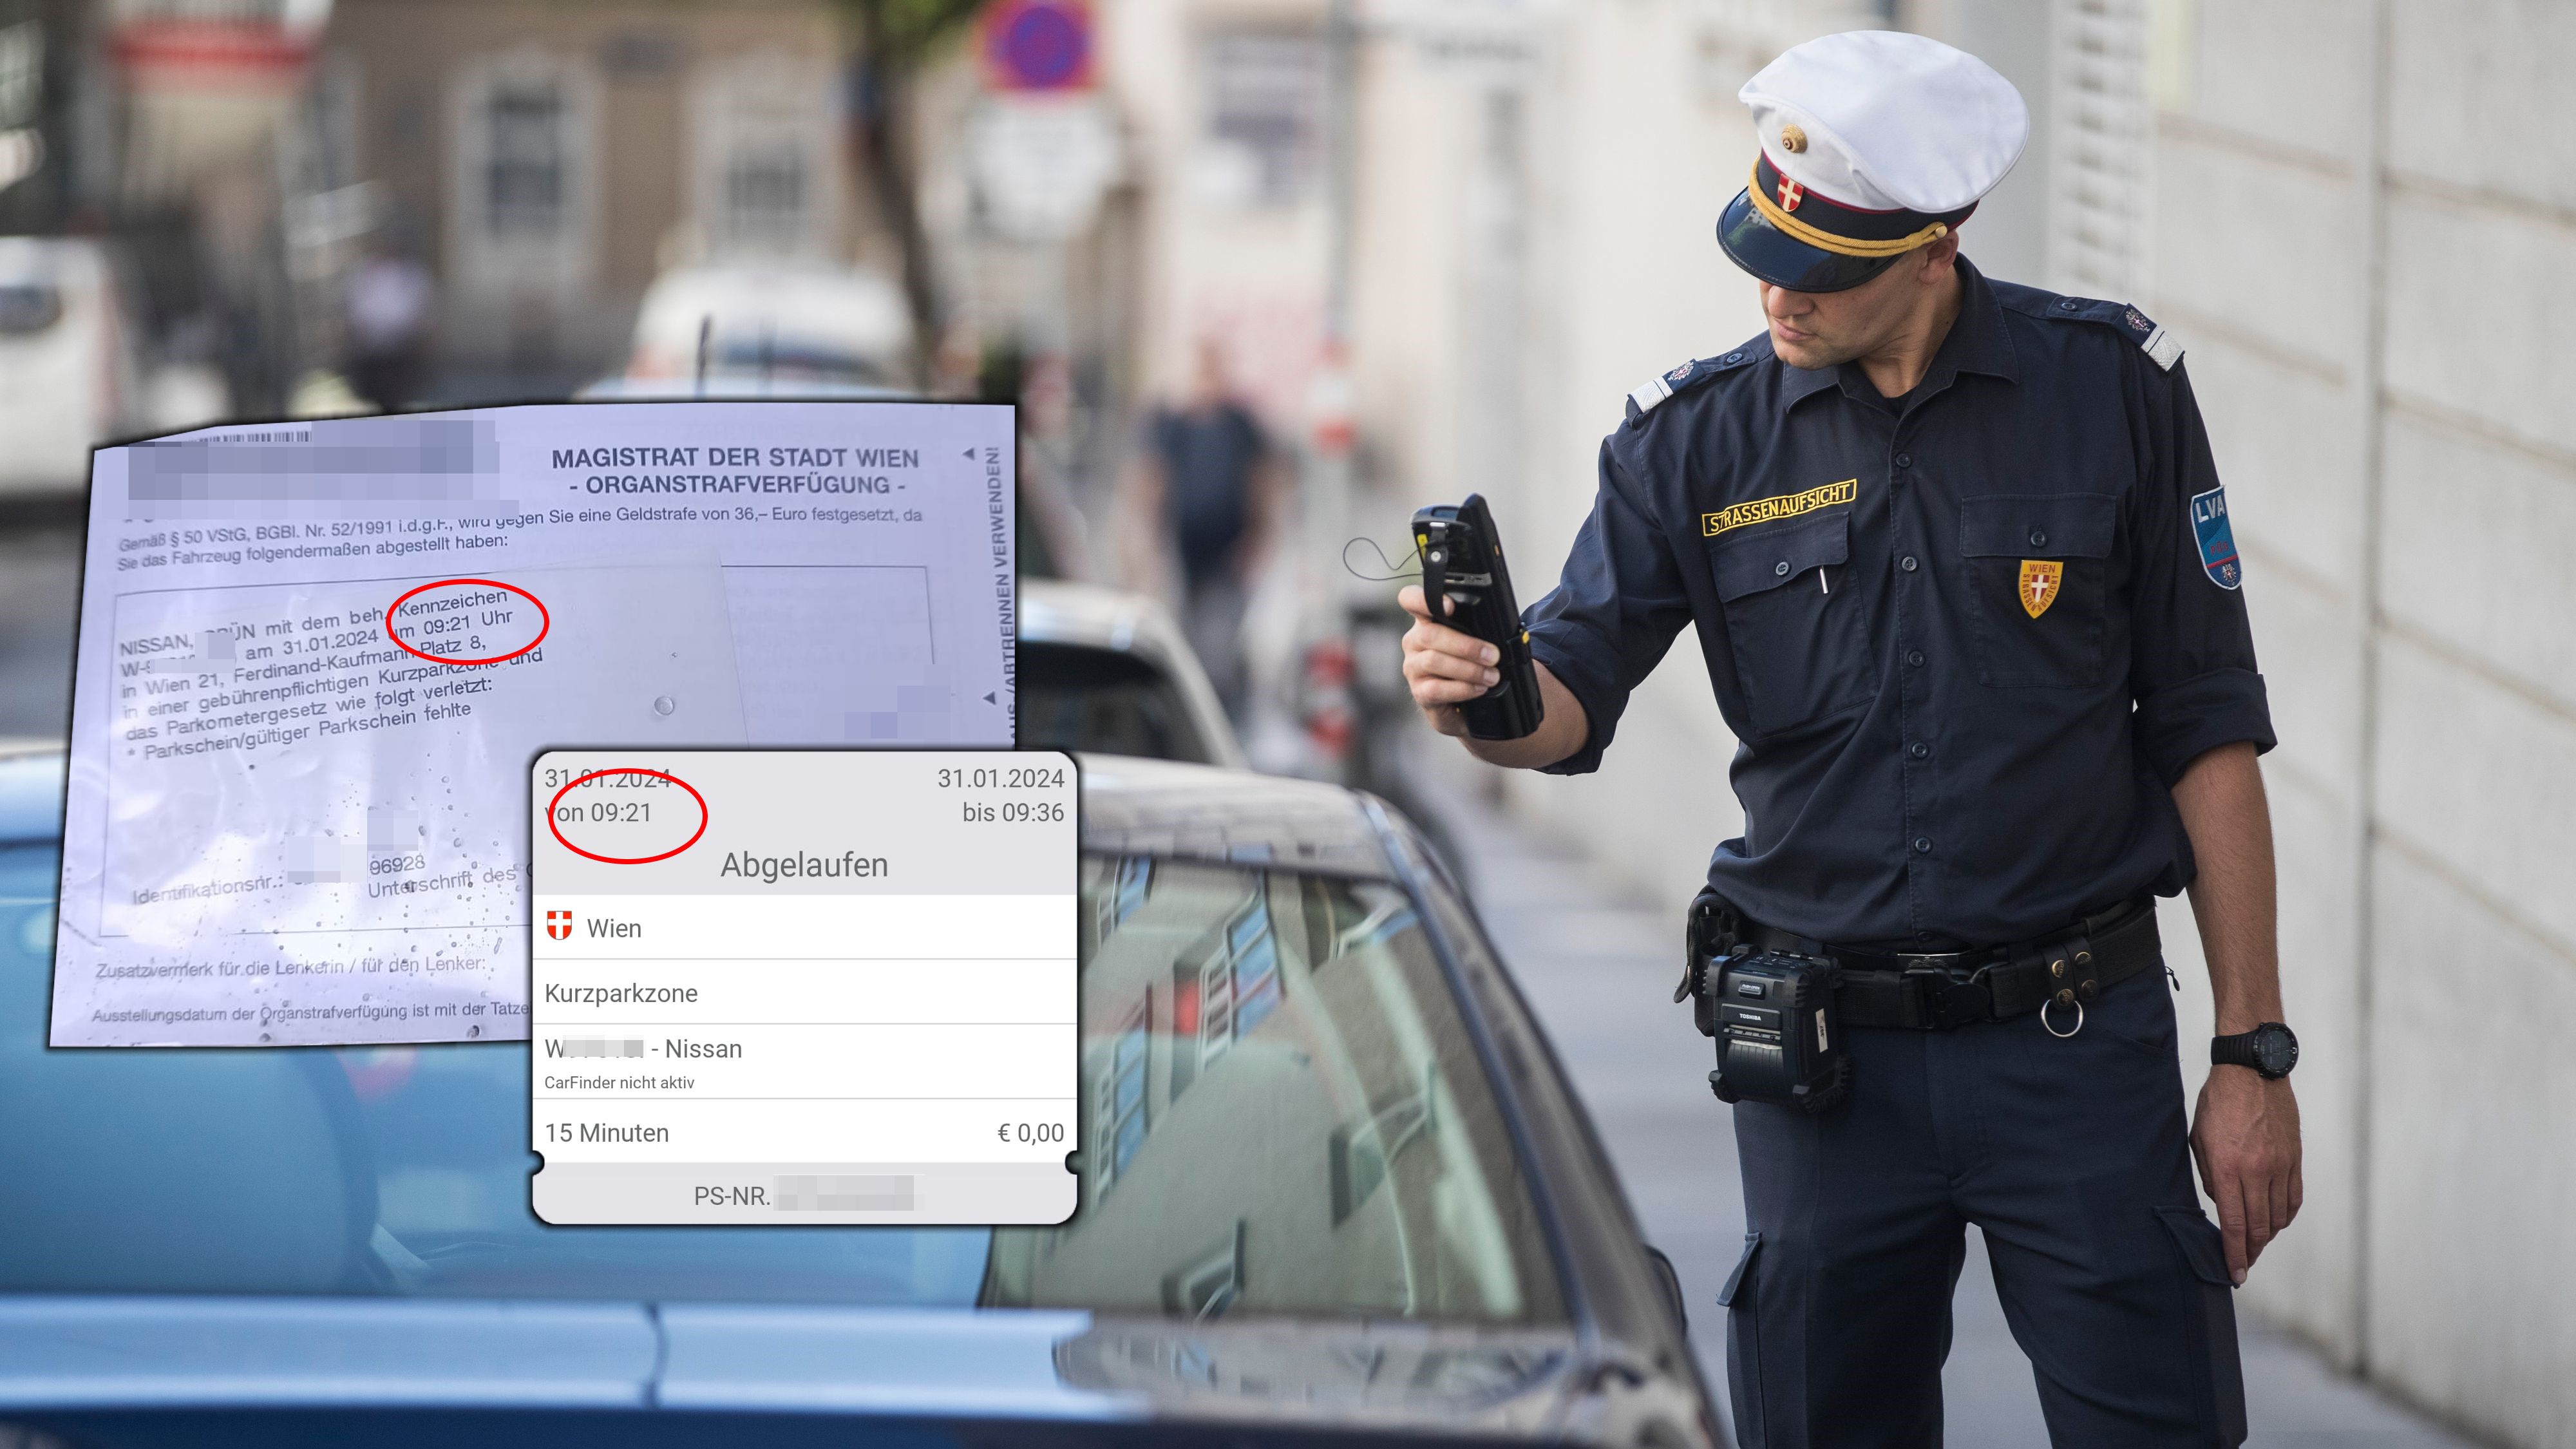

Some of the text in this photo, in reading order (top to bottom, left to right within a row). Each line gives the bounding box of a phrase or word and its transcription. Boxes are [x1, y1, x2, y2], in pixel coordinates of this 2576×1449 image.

[552, 448, 919, 469] MAGISTRAT DER STADT WIEN
[586, 471, 890, 494] ORGANSTRAFVERFÜGUNG
[985, 447, 1008, 568] VERWENDEN!
[1710, 484, 1850, 533] STRASSENAUFSICHT
[2195, 495, 2226, 523] LVA
[119, 533, 166, 552] Gemäß
[170, 531, 180, 548] §
[184, 529, 203, 544] 50
[207, 527, 251, 543] VStG,
[305, 524, 326, 538] Nr.
[331, 520, 392, 536] 52/1991
[549, 509, 574, 523] Sie
[579, 508, 611, 522] eine
[616, 507, 697, 521] Geldstrafe
[702, 508, 730, 521] von
[773, 507, 807, 521] Euro
[811, 507, 898, 525] festgesetzt,
[903, 509, 923, 522] da
[118, 534, 508, 572] Sie das Fahrzeug folgendermaßen abgestellt haben:
[2029, 564, 2056, 573] WIEN
[120, 591, 507, 656] NISSAN, ÜN mit dem beh. Kennzeichen
[246, 646, 273, 661] am
[283, 629, 379, 655] 31.01.2024
[424, 614, 469, 635] 09:21
[482, 609, 513, 627] Uhr
[122, 684, 137, 699] in
[146, 678, 191, 696] Wien
[198, 674, 224, 688] 21,
[470, 635, 486, 651] 8,
[124, 705, 138, 720] in
[148, 699, 189, 716] einer
[199, 674, 369, 713] gebührenpflichtigen
[509, 647, 542, 666] und
[126, 677, 492, 741] das Parkometergesetz wie folgt verletzt:
[146, 702, 471, 760] Parkschein/gültiger Parkschein fehlte
[368, 871, 473, 898] Unterschrift
[483, 867, 516, 884] des
[370, 855, 426, 875] 96928
[95, 961, 213, 978] Zusatzvermerk
[219, 960, 240, 976] für
[246, 960, 270, 976] die
[276, 959, 344, 975] Lenkerin
[362, 957, 383, 972] für
[389, 957, 419, 973] den
[426, 956, 485, 971] Lenker:
[92, 1001, 533, 1025] Ausstellungsdatum der Organstrafverfügung ist mit der Tatze
[1739, 1013, 1761, 1021] TOSHIBA
